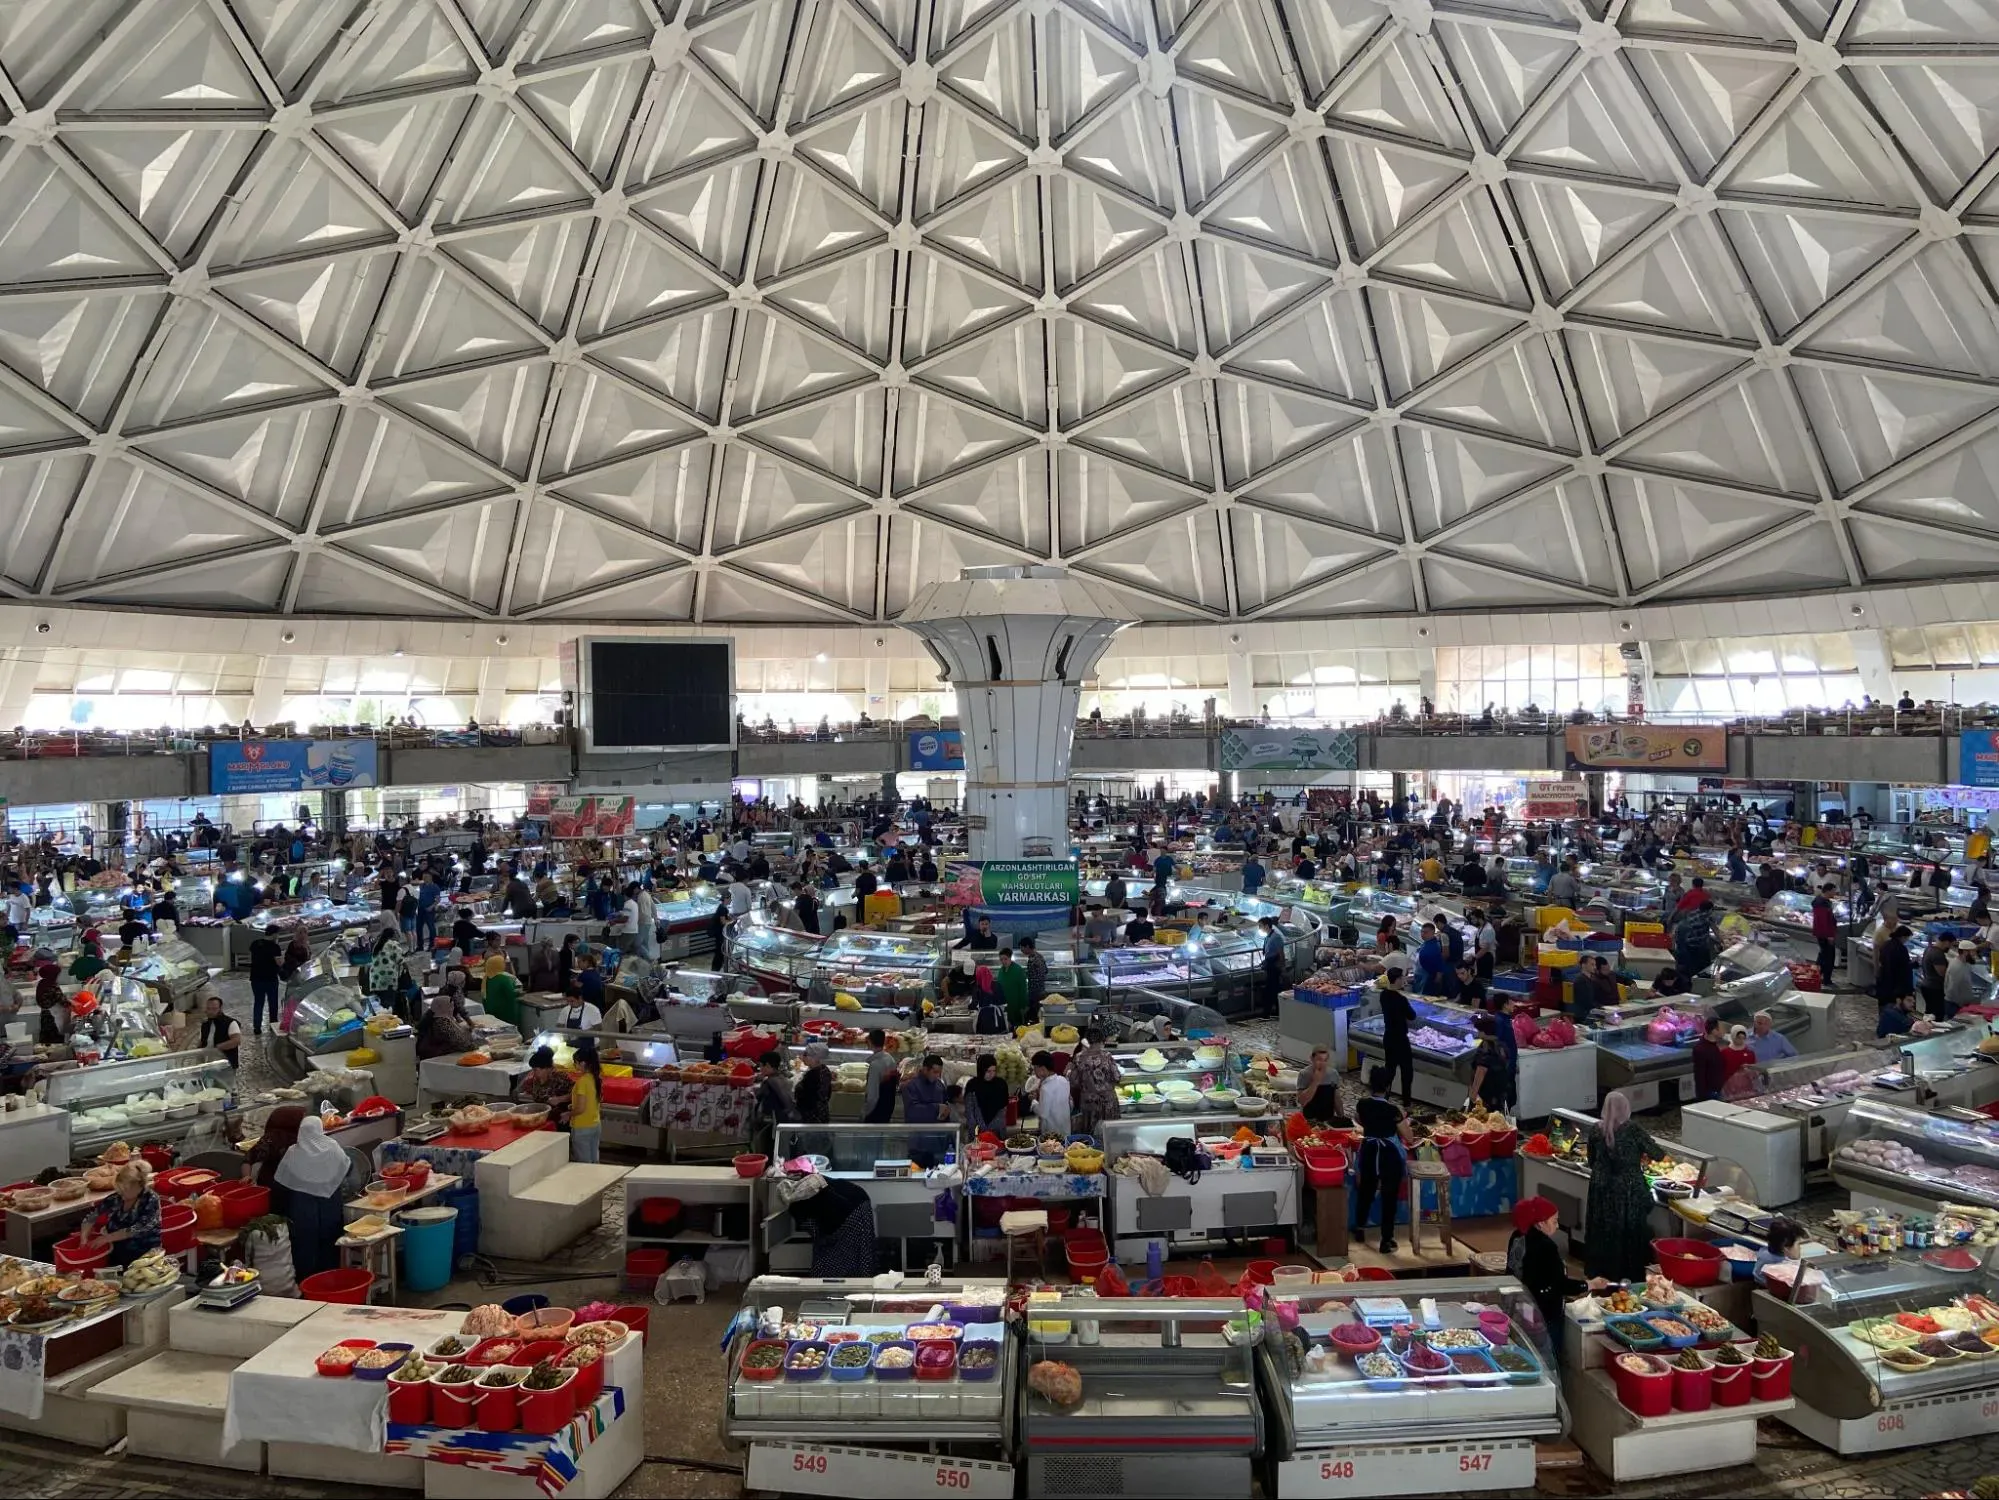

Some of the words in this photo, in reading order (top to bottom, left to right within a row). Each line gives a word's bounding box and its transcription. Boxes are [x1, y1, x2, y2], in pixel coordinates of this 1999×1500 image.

[989, 863, 1075, 872] ARZONLASHTIRILGAN
[1001, 882, 1063, 890] MAHSULOTLARI
[997, 891, 1070, 902] YARMARKASI
[1982, 1400, 1999, 1417] 60
[1877, 1414, 1904, 1432] 608
[793, 1453, 828, 1474] 549
[1320, 1461, 1354, 1480] 548
[1459, 1454, 1493, 1472] 547
[935, 1468, 970, 1489] 550
